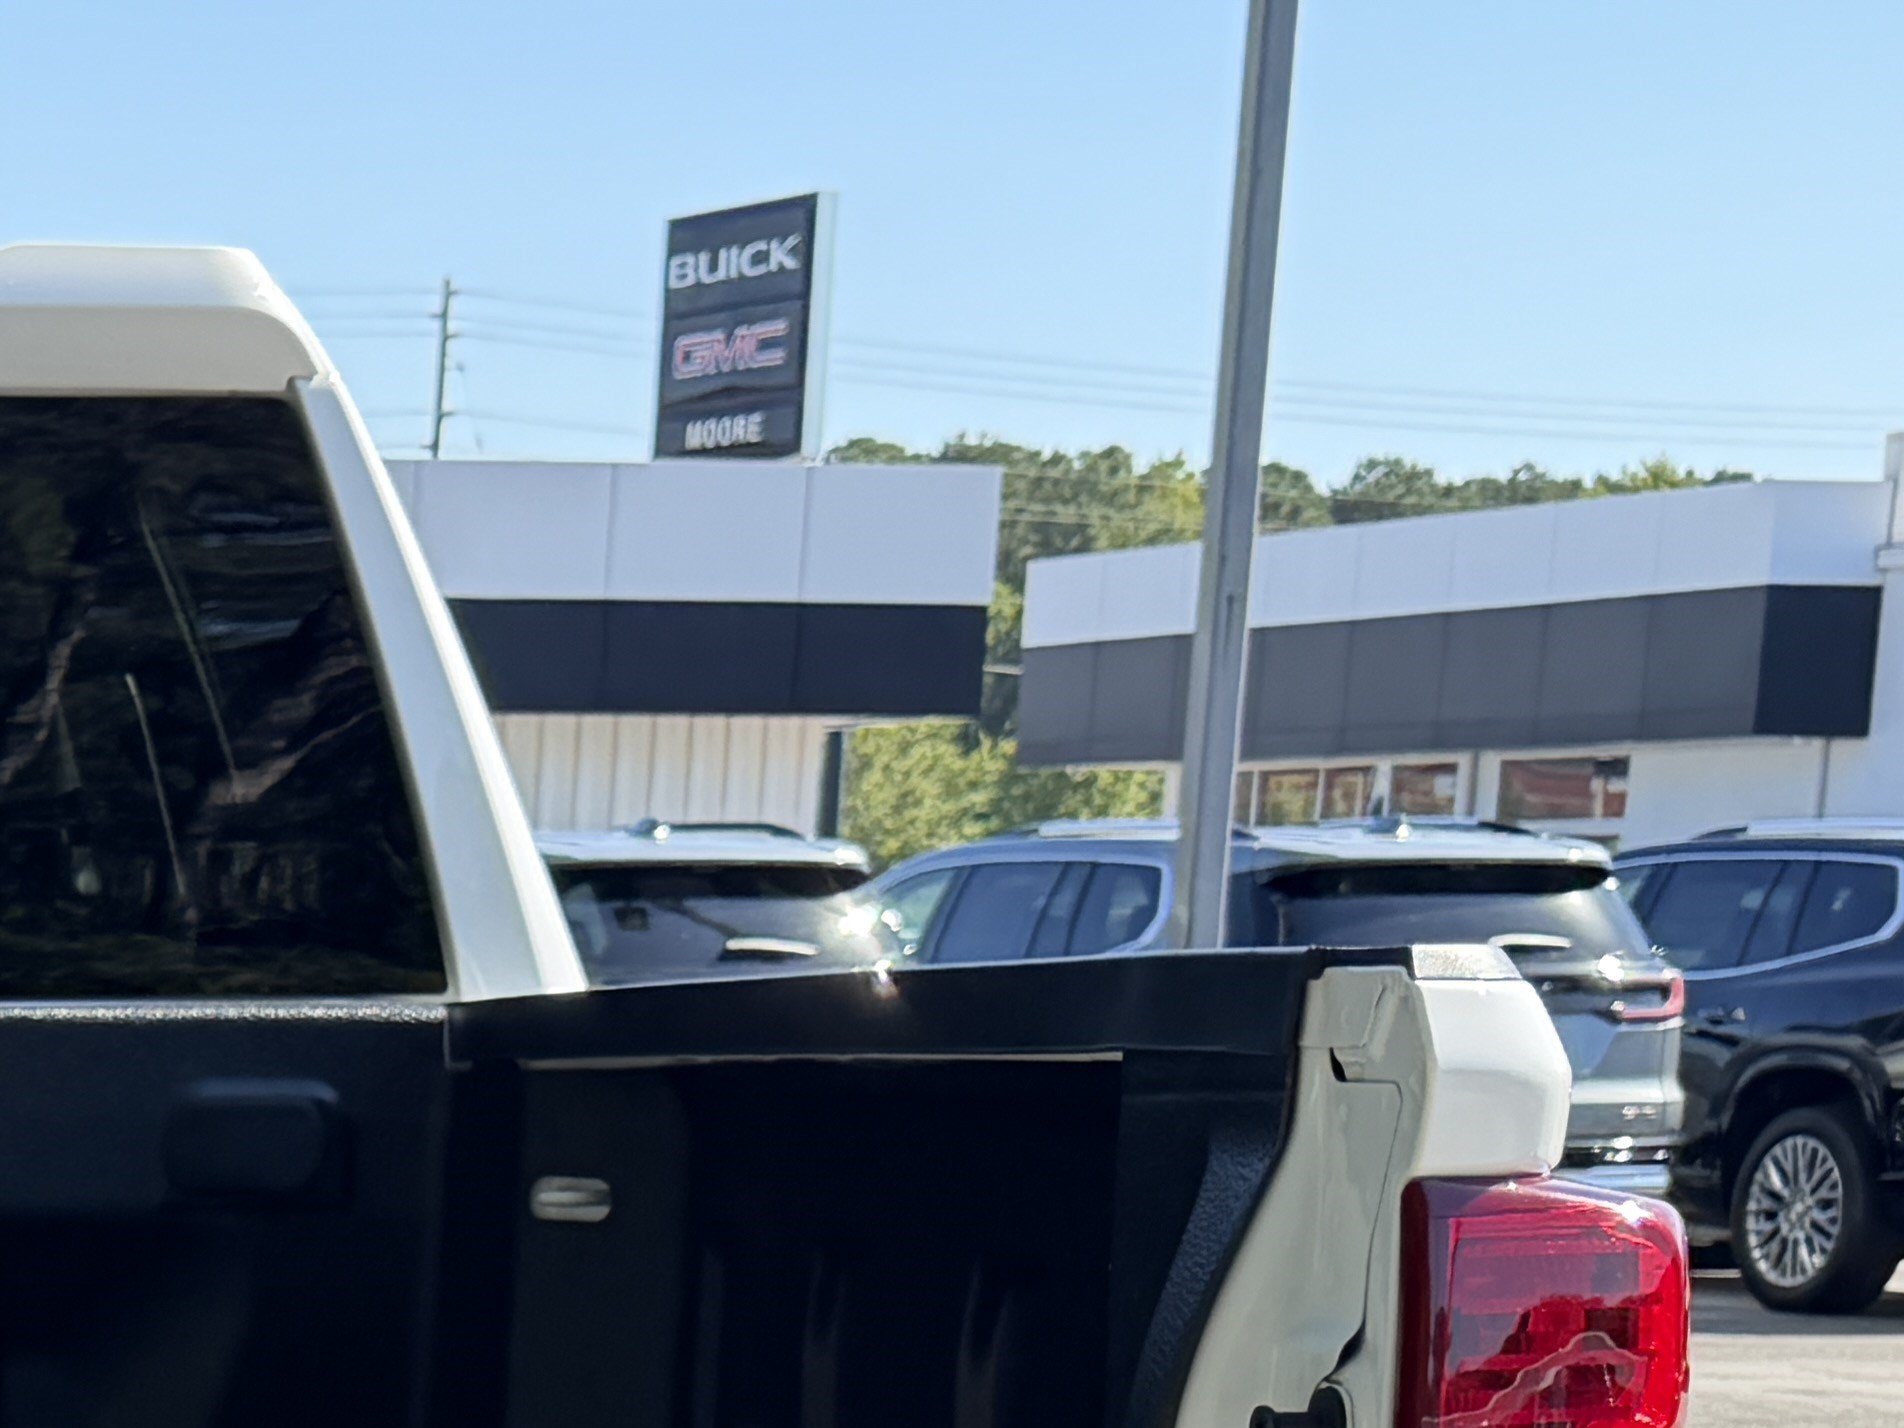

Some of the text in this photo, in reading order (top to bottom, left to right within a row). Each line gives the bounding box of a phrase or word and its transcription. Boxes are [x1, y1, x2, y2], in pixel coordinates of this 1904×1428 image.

[668, 233, 801, 289] BUICK
[672, 318, 790, 380] GMC
[685, 411, 765, 450] MOORE
